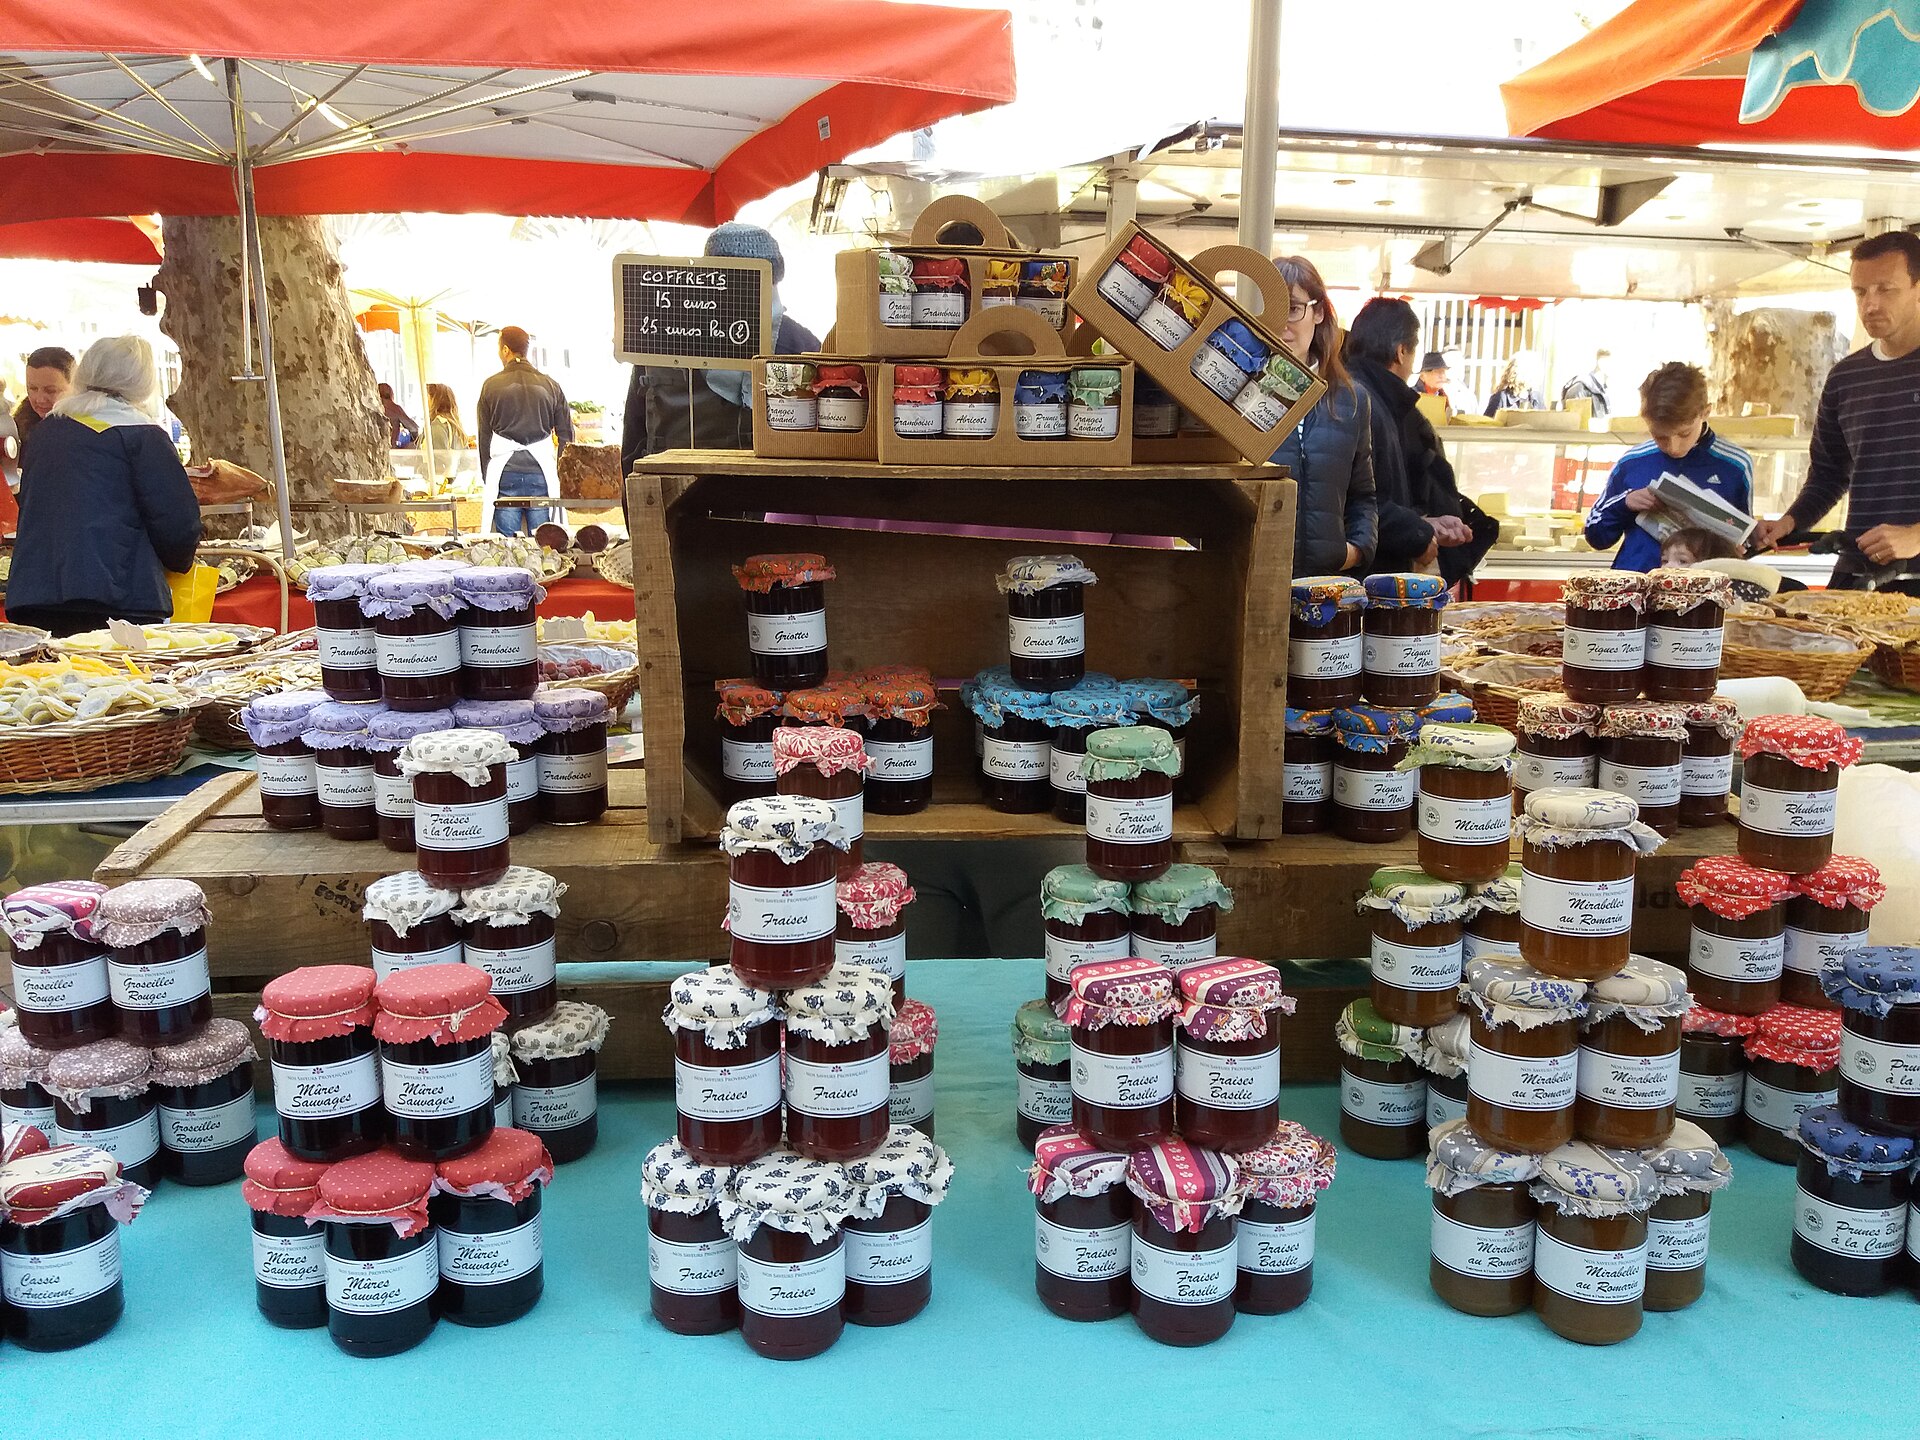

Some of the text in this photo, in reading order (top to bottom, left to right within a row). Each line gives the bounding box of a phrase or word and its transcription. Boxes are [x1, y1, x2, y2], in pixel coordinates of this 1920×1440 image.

[641, 269, 728, 288] COFFRETS
[655, 290, 717, 311] 15 euros
[665, 325, 702, 337] euros
[818, 411, 847, 421] ramboises
[955, 415, 987, 425] Abricots
[1073, 413, 1103, 426] Oranges
[1073, 422, 1105, 432] Lavande
[775, 629, 809, 645] Griottes
[1023, 634, 1080, 648] Cerises Noires
[330, 646, 377, 658] Framboise
[470, 644, 521, 656] Framboises
[1402, 647, 1431, 660] Figues
[1587, 643, 1619, 656] Figues
[1671, 642, 1703, 656] Figues
[387, 653, 438, 665] Framboises
[1321, 651, 1350, 665] Figues
[1398, 660, 1415, 669] aux
[1317, 664, 1333, 673] aux
[883, 757, 917, 770] Griottes
[989, 756, 1045, 769] Cerises Noires
[262, 772, 308, 783] Framboises
[543, 770, 593, 782] Framboises
[1553, 771, 1582, 783] Figues
[1683, 769, 1715, 781] Figues
[324, 783, 373, 795] Framboises
[1293, 776, 1321, 789] Figues
[1638, 780, 1669, 793] Figues
[1288, 787, 1304, 796] aux
[1374, 784, 1403, 796] Figues
[430, 813, 470, 827] Fraises
[1118, 812, 1156, 825] Fraises
[1454, 817, 1507, 831] Mirabelles
[1789, 816, 1826, 831] Rouges
[422, 825, 483, 838] à la Vanille
[1105, 822, 1164, 836] à la Menthe
[1568, 897, 1624, 911] Mirabelles
[761, 913, 808, 928] Fraises
[1559, 913, 1623, 926] au Romarin
[851, 954, 889, 966] Fraises
[482, 964, 522, 976] Fraises
[1743, 963, 1777, 977] Rouges
[23, 979, 74, 991] Groseilles
[123, 977, 175, 991] Groseilles
[496, 975, 534, 987] Vanille
[27, 991, 66, 1004] Rouges
[128, 990, 167, 1003] Rouges
[1117, 1074, 1159, 1089] Fraises
[1208, 1072, 1254, 1086] Fraises
[1521, 1072, 1573, 1085] Mirabelles
[1611, 1071, 1668, 1084] Mirabelles
[1885, 1073, 1913, 1086] à la
[296, 1083, 340, 1096] Mûres
[402, 1082, 444, 1095] Mûres
[812, 1086, 858, 1101] Fraises
[1118, 1088, 1158, 1102] Basilic
[1210, 1086, 1252, 1100] Basilic
[1511, 1087, 1572, 1100] au Romarin
[1602, 1086, 1667, 1099] au Romarin
[291, 1094, 352, 1110] Sauvages
[397, 1093, 455, 1109] Sauvages
[701, 1089, 748, 1103] Fraises
[1035, 1092, 1071, 1104] Fraises
[529, 1102, 568, 1114] Fraises
[1024, 1101, 1072, 1115] à la Ment
[1698, 1098, 1733, 1112] Rouges
[521, 1110, 579, 1123] à la Vanille
[171, 1121, 221, 1134] Groseilles
[176, 1133, 214, 1147] Rouges
[1836, 1220, 1880, 1237] Prunes
[1657, 1233, 1706, 1246] Mirabelles
[1831, 1233, 1858, 1248] à la
[457, 1247, 499, 1260] Mûres
[1075, 1247, 1118, 1260] Fraises
[1257, 1241, 1299, 1256] Fraises
[1477, 1241, 1529, 1254] Mirabelles
[1648, 1247, 1705, 1260] au Romarin
[266, 1251, 307, 1265] Mûres
[868, 1254, 913, 1270] Fraises
[1258, 1255, 1298, 1268] Basilic
[1467, 1255, 1528, 1268] au Romarin
[262, 1262, 318, 1279] Sauvages
[451, 1258, 509, 1275] Sauvages
[1076, 1260, 1117, 1274] Basilic
[1585, 1265, 1640, 1279] Mirabelles
[20, 1273, 60, 1287] Cassis
[679, 1267, 725, 1282] Fraises
[1176, 1270, 1220, 1284] Fraises
[347, 1276, 390, 1290] Mûres
[1575, 1279, 1639, 1293] au Romarin
[341, 1287, 401, 1305] Sauvages
[769, 1287, 817, 1301] Fraises
[1177, 1283, 1218, 1298] Basilic
